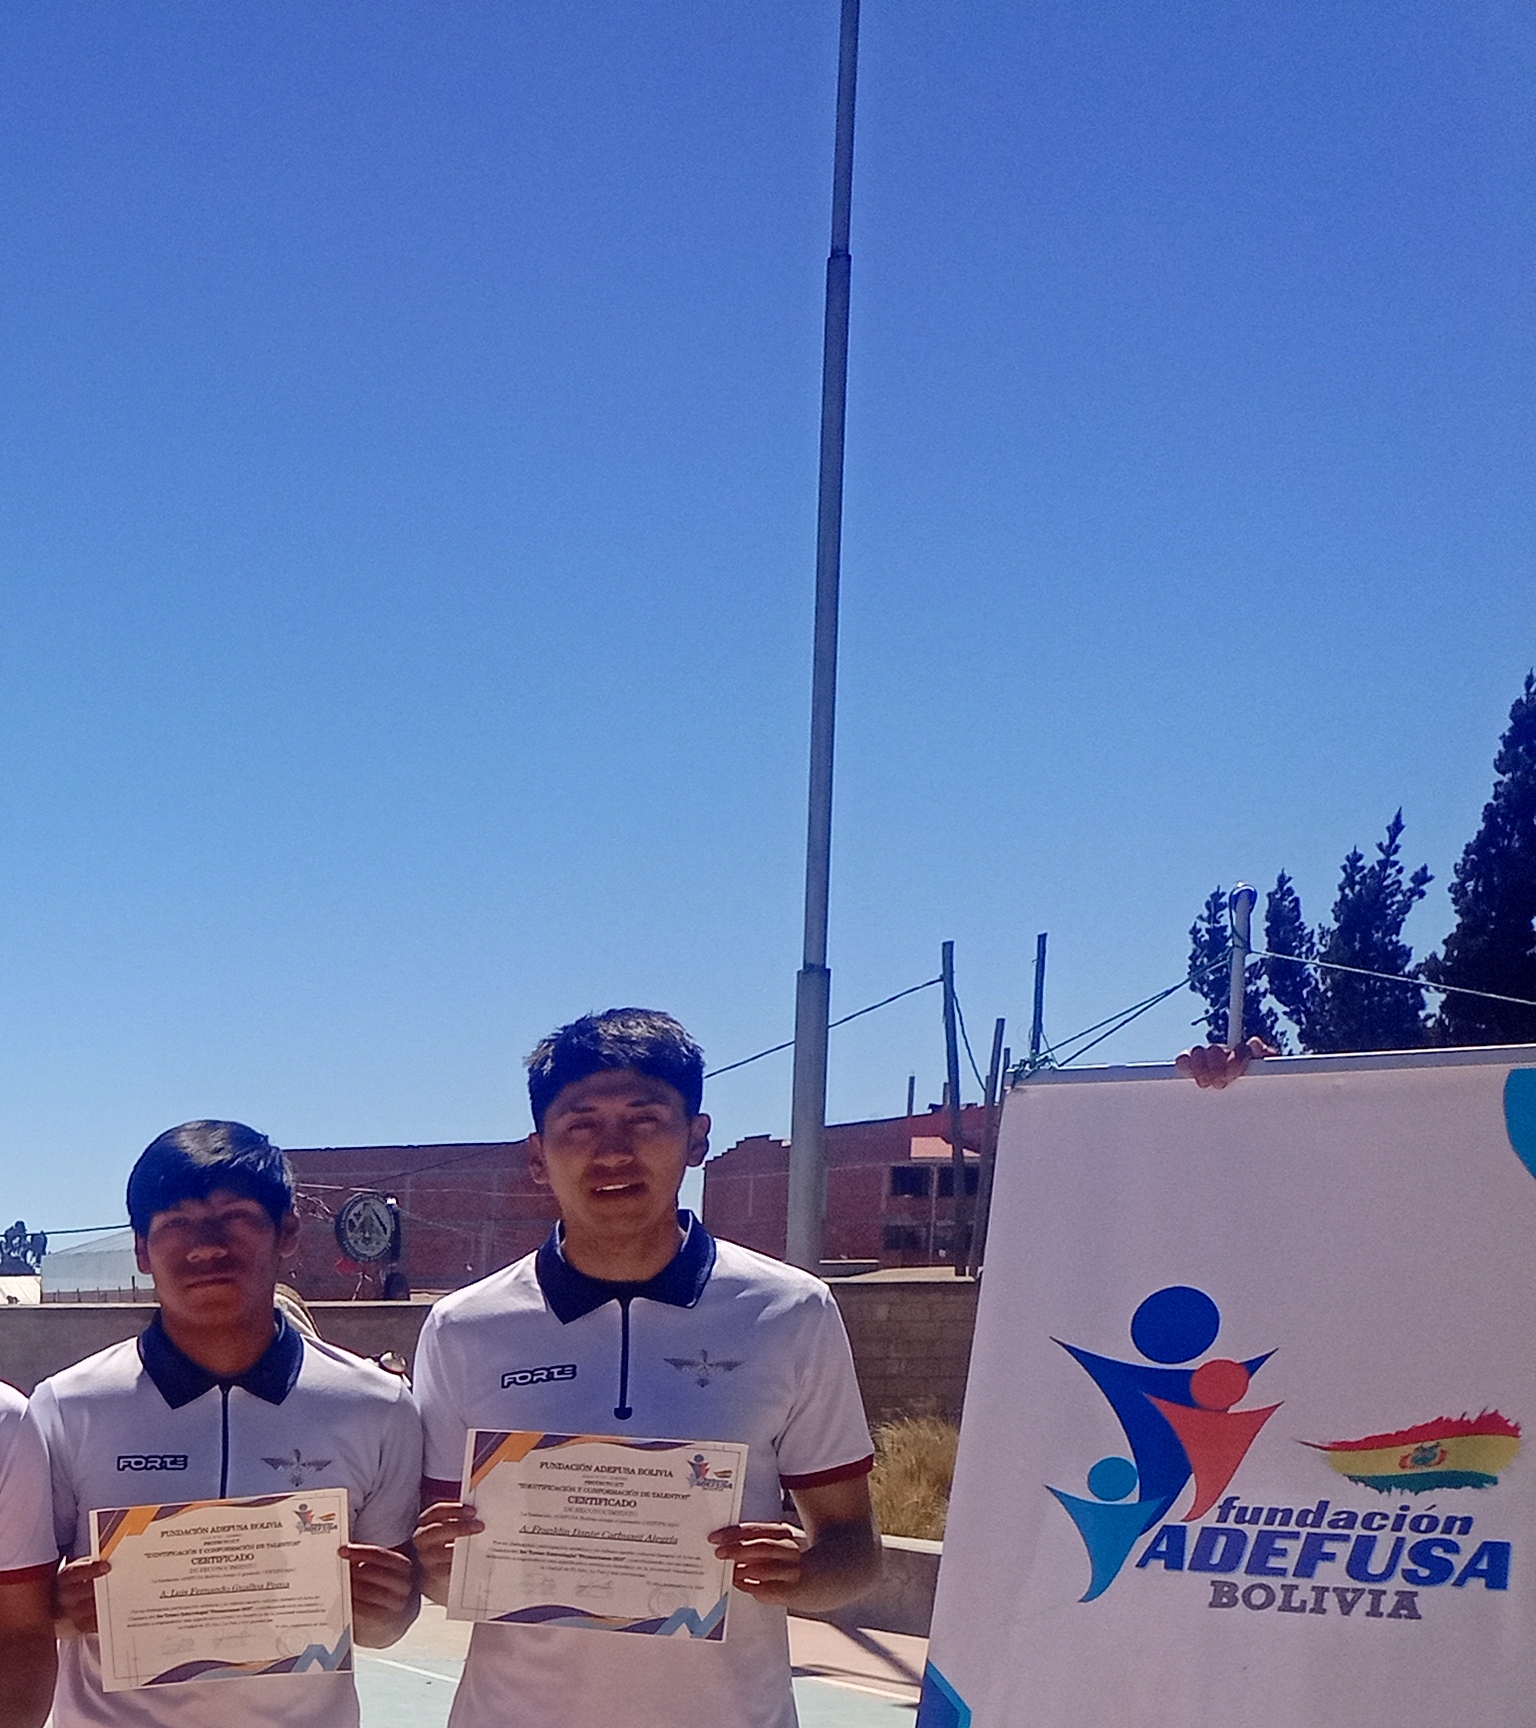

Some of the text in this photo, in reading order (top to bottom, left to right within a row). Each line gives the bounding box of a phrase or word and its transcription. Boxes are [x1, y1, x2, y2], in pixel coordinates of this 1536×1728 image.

[502, 1366, 575, 1387] FORTE
[118, 1456, 186, 1470] FORTE
[567, 1495, 638, 1507] CERTIFICADO
[1215, 1496, 1474, 1535] fundación
[191, 1552, 254, 1565] CERTIFICADO
[1135, 1525, 1511, 1590] ADEFUSA
[1208, 1580, 1422, 1620] BOLIVIA
